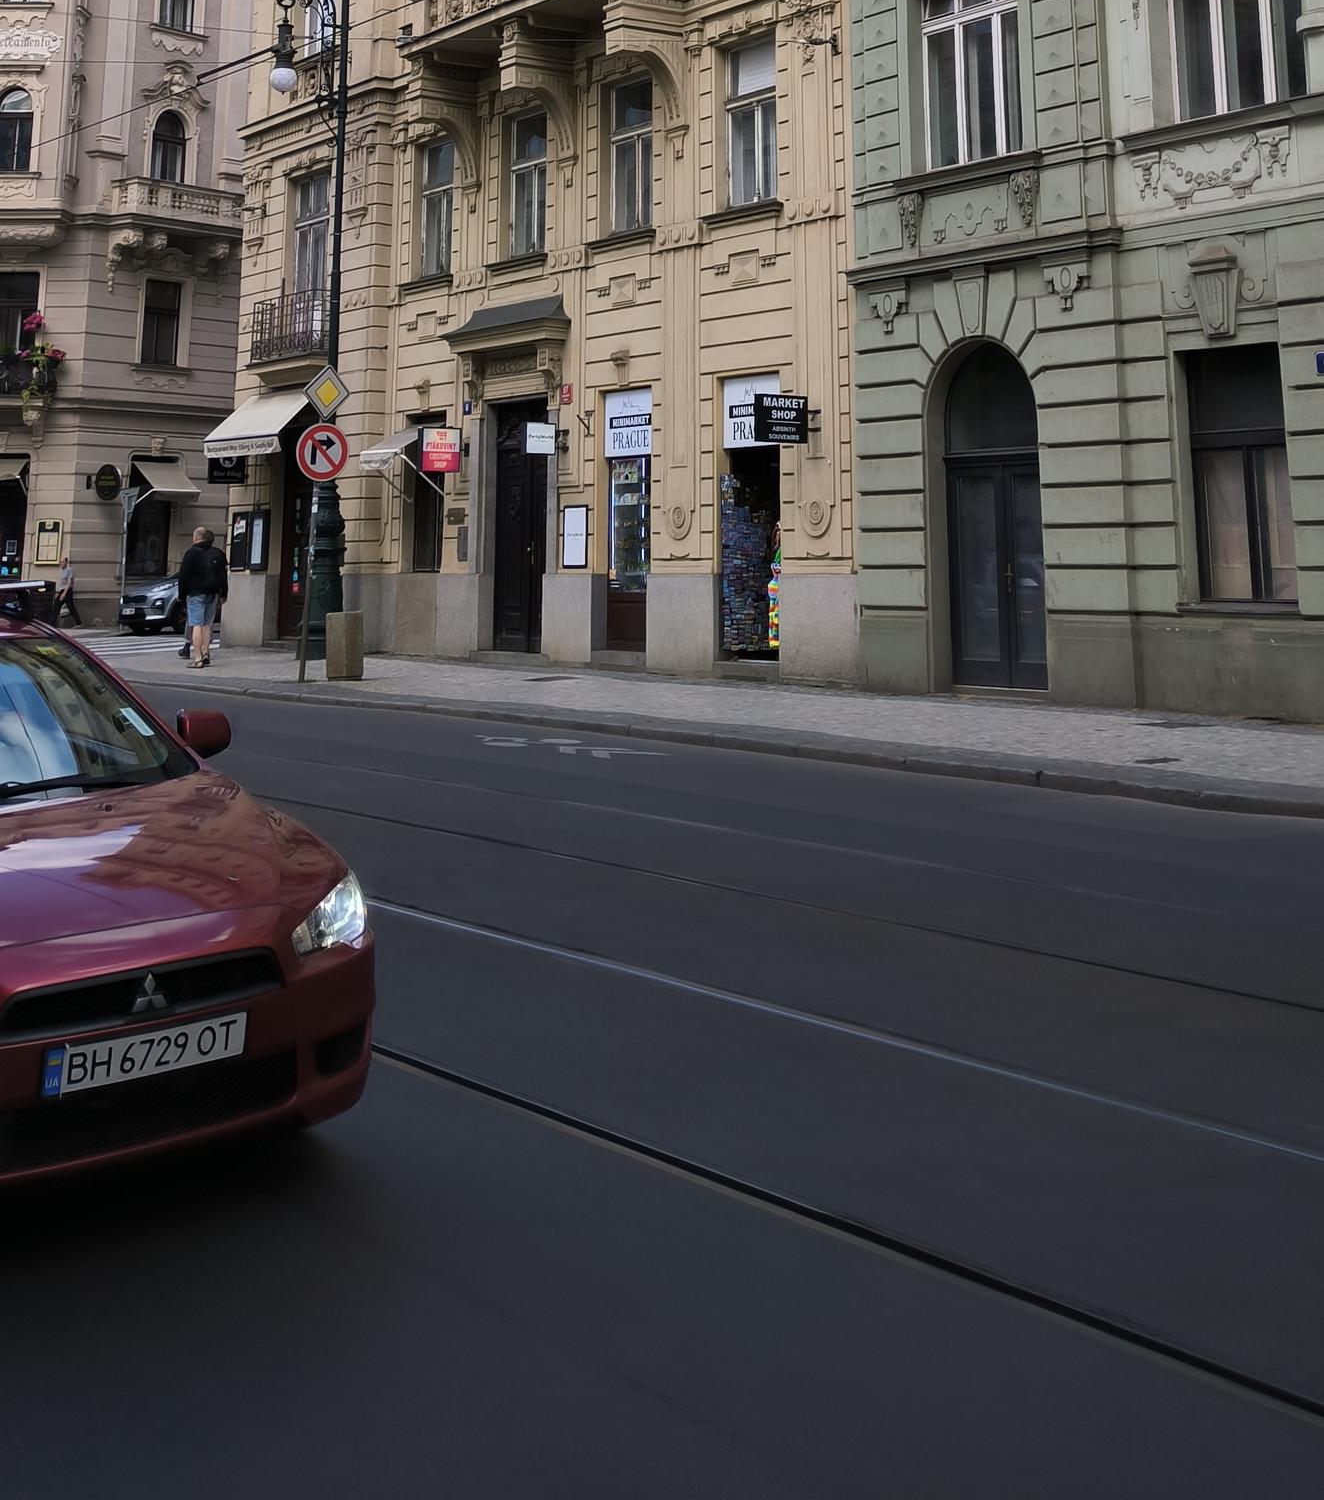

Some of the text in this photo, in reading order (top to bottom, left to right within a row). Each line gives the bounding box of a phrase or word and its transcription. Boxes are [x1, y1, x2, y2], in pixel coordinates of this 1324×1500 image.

[763, 396, 805, 408] MARKET
[771, 410, 797, 419] SHOP
[612, 415, 650, 427] MINIMARKET
[612, 430, 649, 450] PRAGUE
[768, 433, 800, 441] SOUVENIRS
[66, 1019, 238, 1085] BH 6729 OT
[45, 1077, 59, 1089] UA
